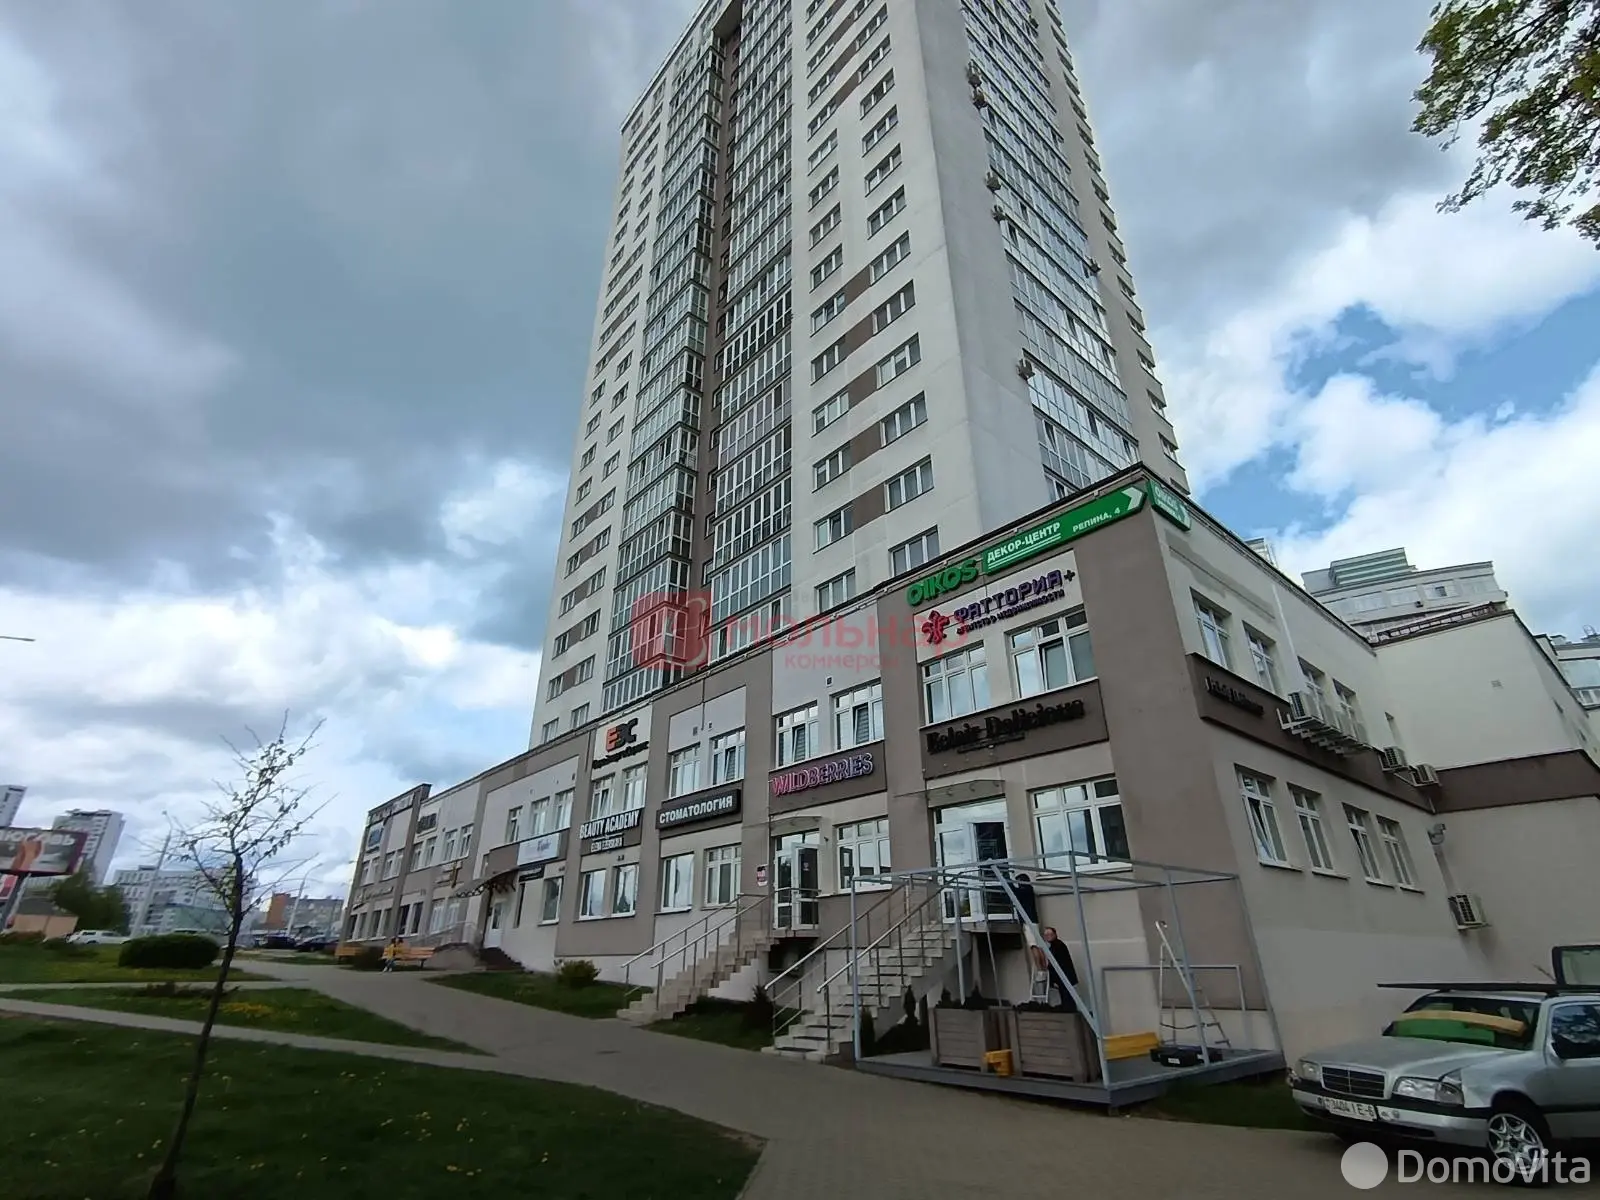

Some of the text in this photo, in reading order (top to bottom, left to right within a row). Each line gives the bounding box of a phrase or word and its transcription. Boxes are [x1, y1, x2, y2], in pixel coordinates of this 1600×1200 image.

[1072, 511, 1112, 532] РЕПИНА,
[987, 522, 1061, 563] ДЕКОР-ЦЕНТР
[906, 559, 979, 606] OIKOS
[773, 753, 873, 797] WILDBERRIES
[580, 810, 640, 839] BEAUTY ACADEMY
[659, 795, 733, 824] СТОМАТОЛОГИЯ
